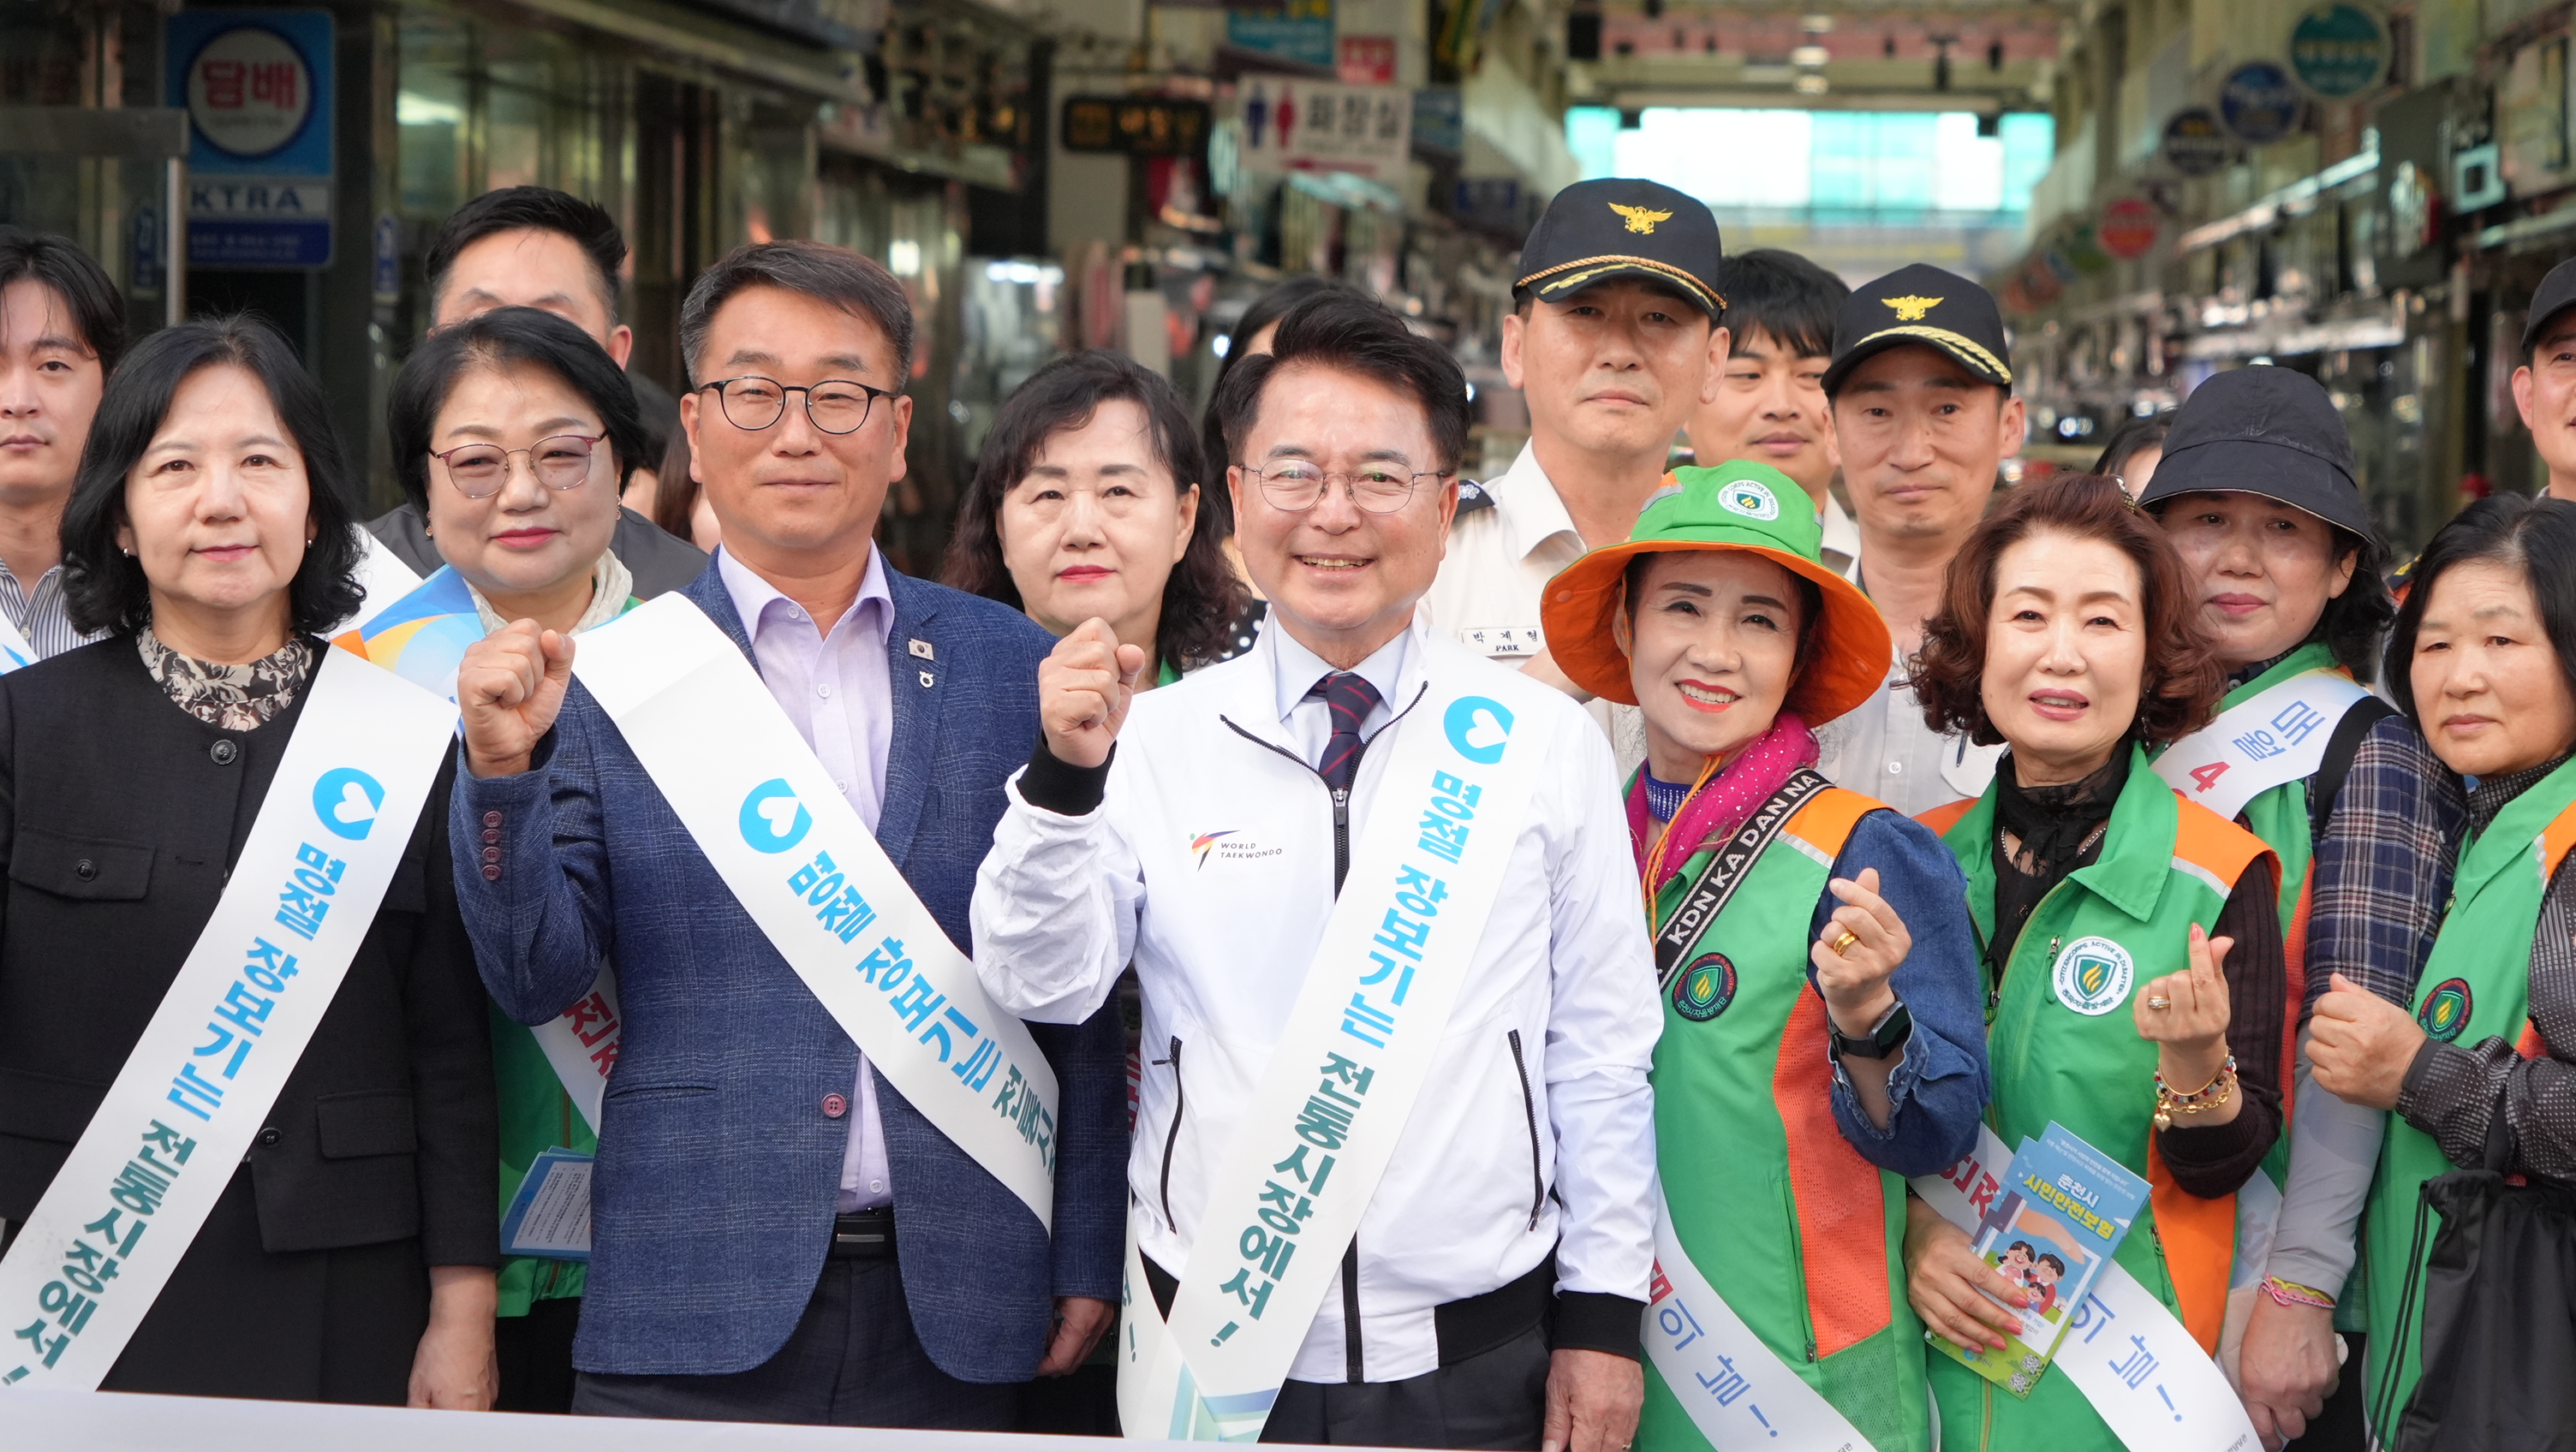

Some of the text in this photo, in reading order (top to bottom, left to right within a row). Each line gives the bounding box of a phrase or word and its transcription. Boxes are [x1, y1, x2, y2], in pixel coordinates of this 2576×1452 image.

[201, 59, 296, 112] 담배
[1308, 93, 1400, 140] 화장실
[191, 185, 303, 210] KTRA
[1473, 631, 1485, 644] 박
[2232, 700, 2326, 762] 매월
[1220, 848, 1283, 859] TAEKWONDO
[1667, 890, 1717, 946] KDN
[788, 850, 877, 944] 명절
[856, 937, 1003, 1093] 장보기는
[2091, 941, 2116, 954] ACTIVE
[2118, 960, 2128, 993] DISASTER
[1210, 770, 1482, 1348] 명절 장보기는 전통시장에서!
[2, 842, 347, 1386] 명절 장보기는 전통시장에서!
[2023, 1173, 2116, 1240] 시민안전보험
[2057, 1173, 2100, 1208] 춘천시
[1695, 1354, 1778, 1437] 날!
[2108, 1335, 2182, 1422] 날!
